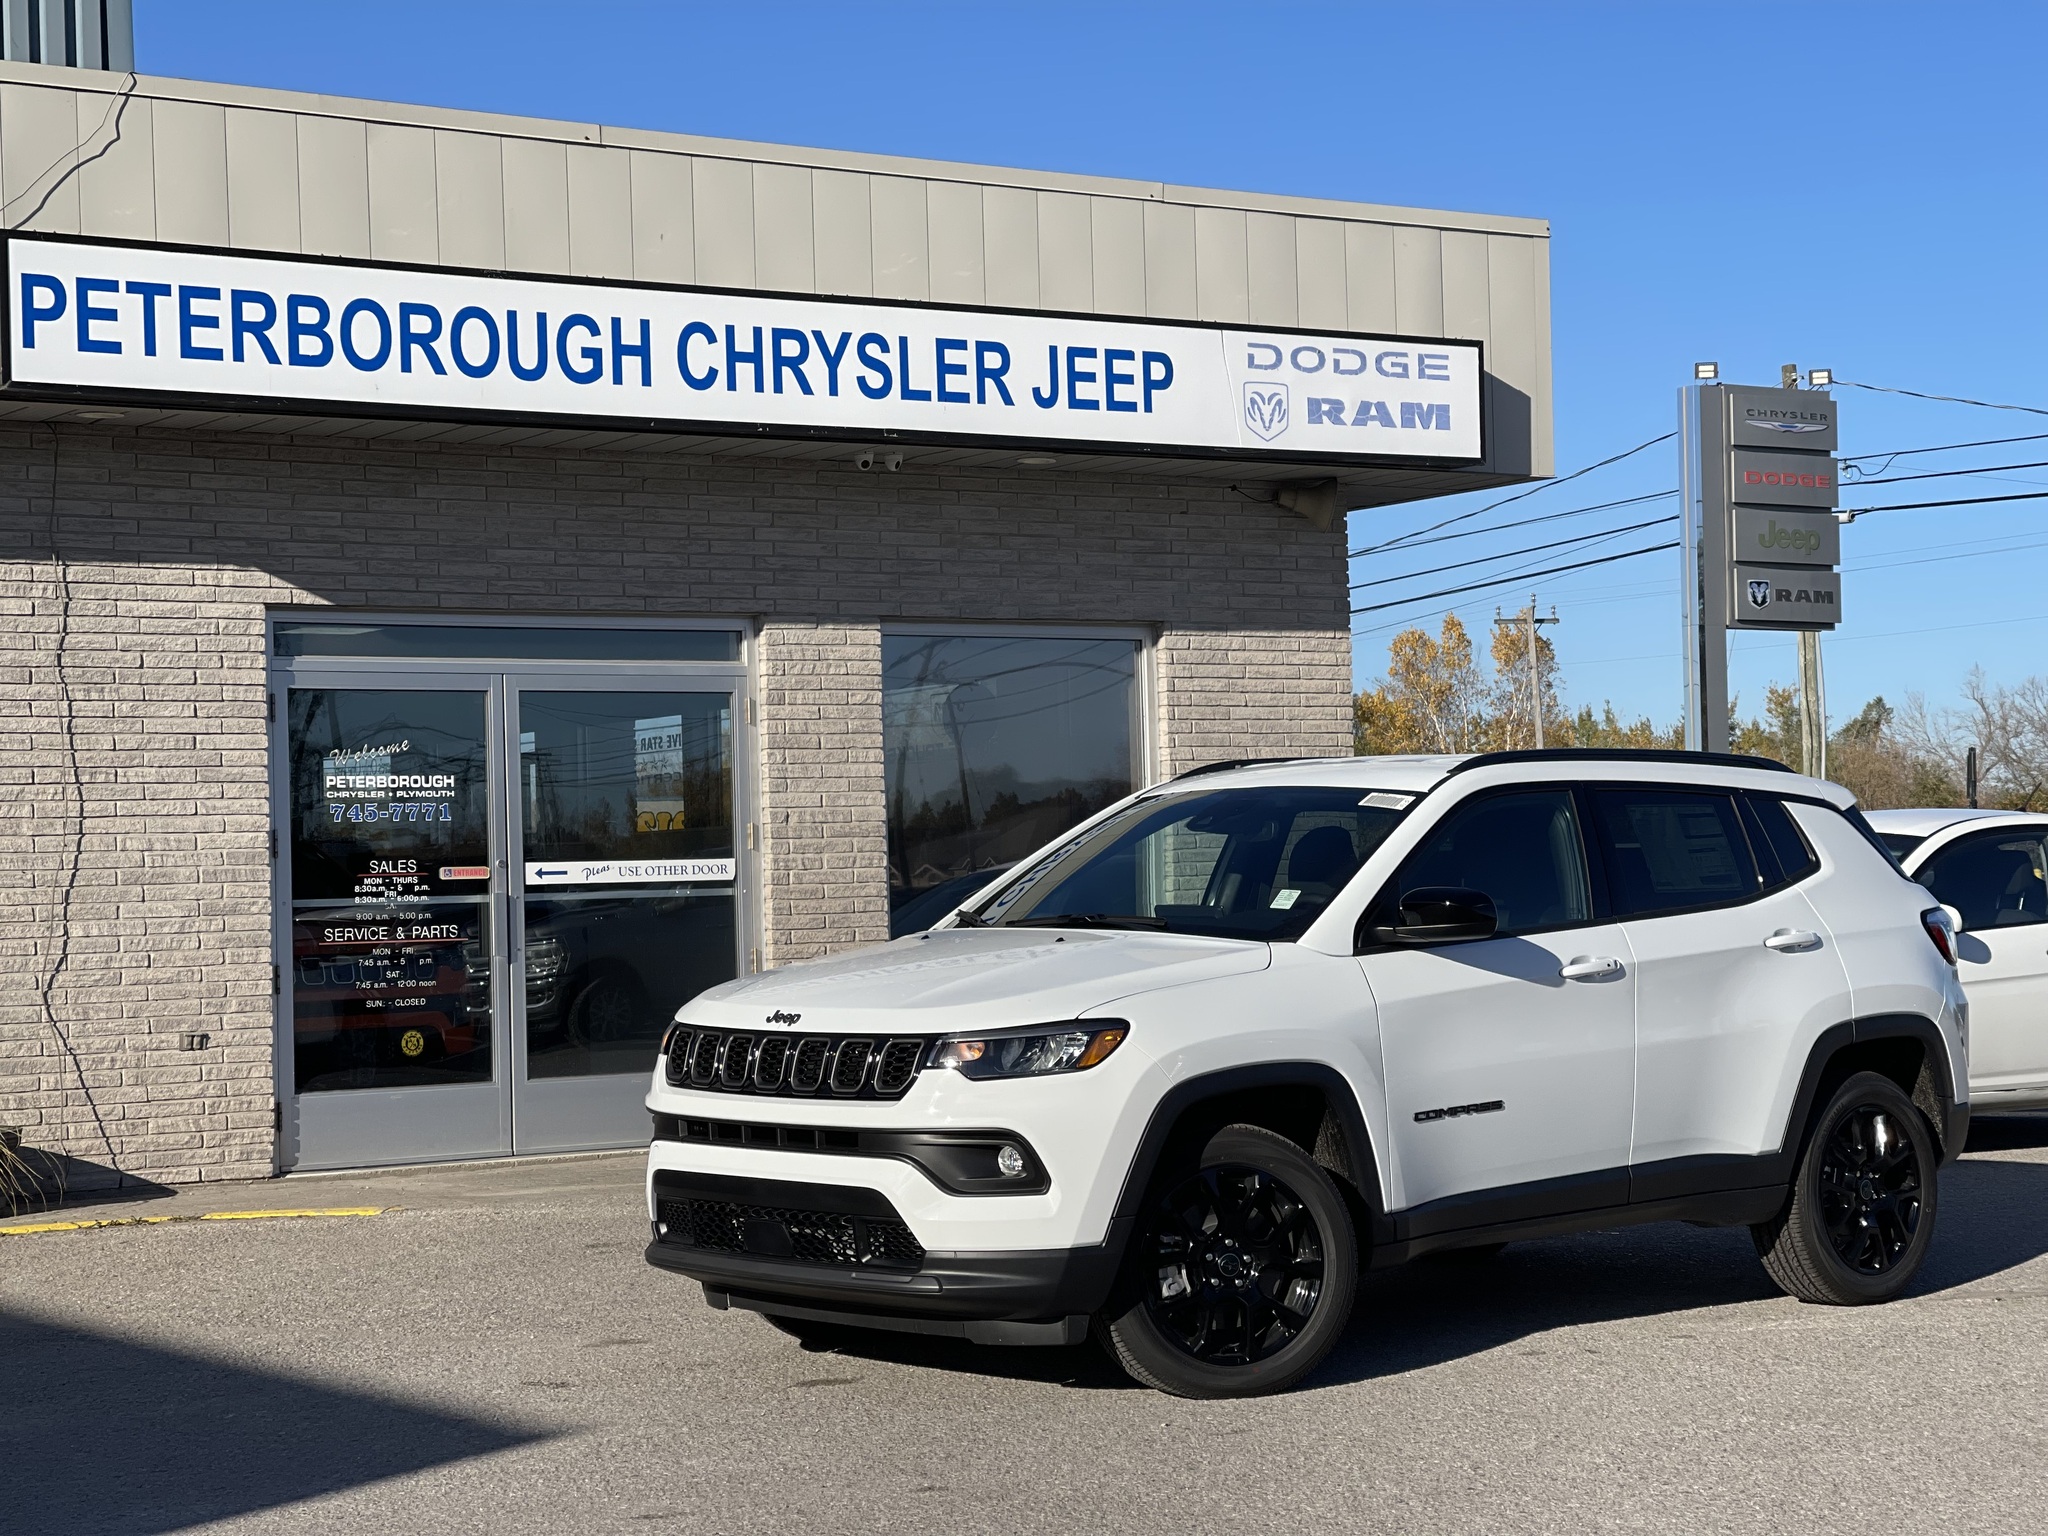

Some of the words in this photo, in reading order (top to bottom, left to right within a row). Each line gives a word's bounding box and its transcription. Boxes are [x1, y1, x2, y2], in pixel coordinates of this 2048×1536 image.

[21, 272, 652, 387] PETERBOROUGH
[677, 321, 1015, 406] CHRYSLER
[1031, 345, 1174, 413] JEEP
[1247, 342, 1450, 381] DODGE
[1307, 397, 1451, 431] RAM
[1745, 408, 1828, 422] CHRYSLER
[1744, 471, 1831, 488] DODGE
[1758, 520, 1820, 555] Jeep
[1775, 588, 1834, 604] RAM
[329, 740, 410, 766] Welcome
[326, 775, 455, 788] PETERBOROUGH
[396, 790, 455, 798] PLYMOUTH
[329, 803, 452, 822] 745-7771
[369, 859, 417, 874] SALES
[453, 869, 486, 877] ENTRANCE
[618, 866, 642, 877] USE
[645, 865, 689, 876] OTHER
[692, 864, 728, 875] DOOR
[392, 876, 418, 884] THURS
[324, 927, 388, 942] SERVICE
[396, 926, 405, 940] &
[412, 925, 458, 939] PARTS
[395, 998, 426, 1006] CLOSED
[766, 1010, 802, 1026] Jeep
[1413, 1100, 1505, 1124] COMPASS
